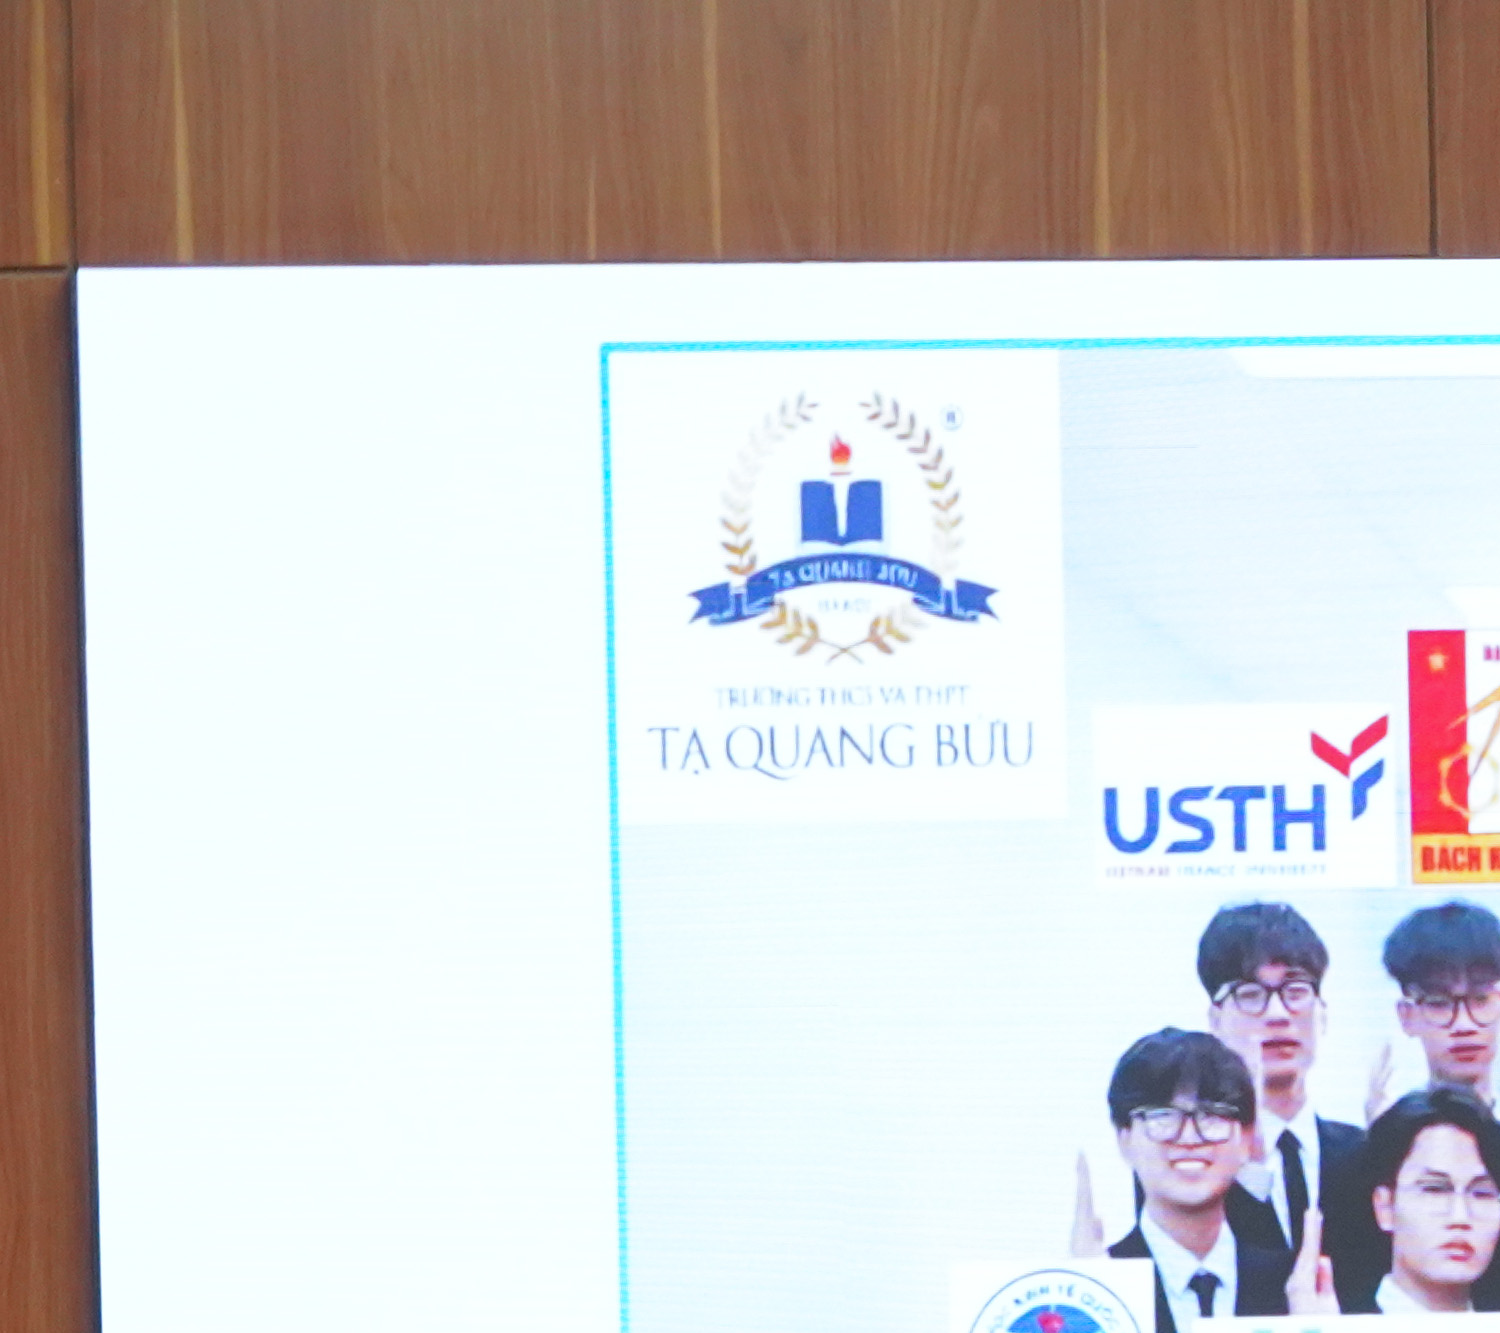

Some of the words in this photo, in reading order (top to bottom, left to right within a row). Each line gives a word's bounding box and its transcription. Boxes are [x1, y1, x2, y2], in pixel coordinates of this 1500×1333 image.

[647, 727, 711, 775] TẠ
[725, 723, 916, 780] QUANG
[1104, 784, 1327, 854] USTH
